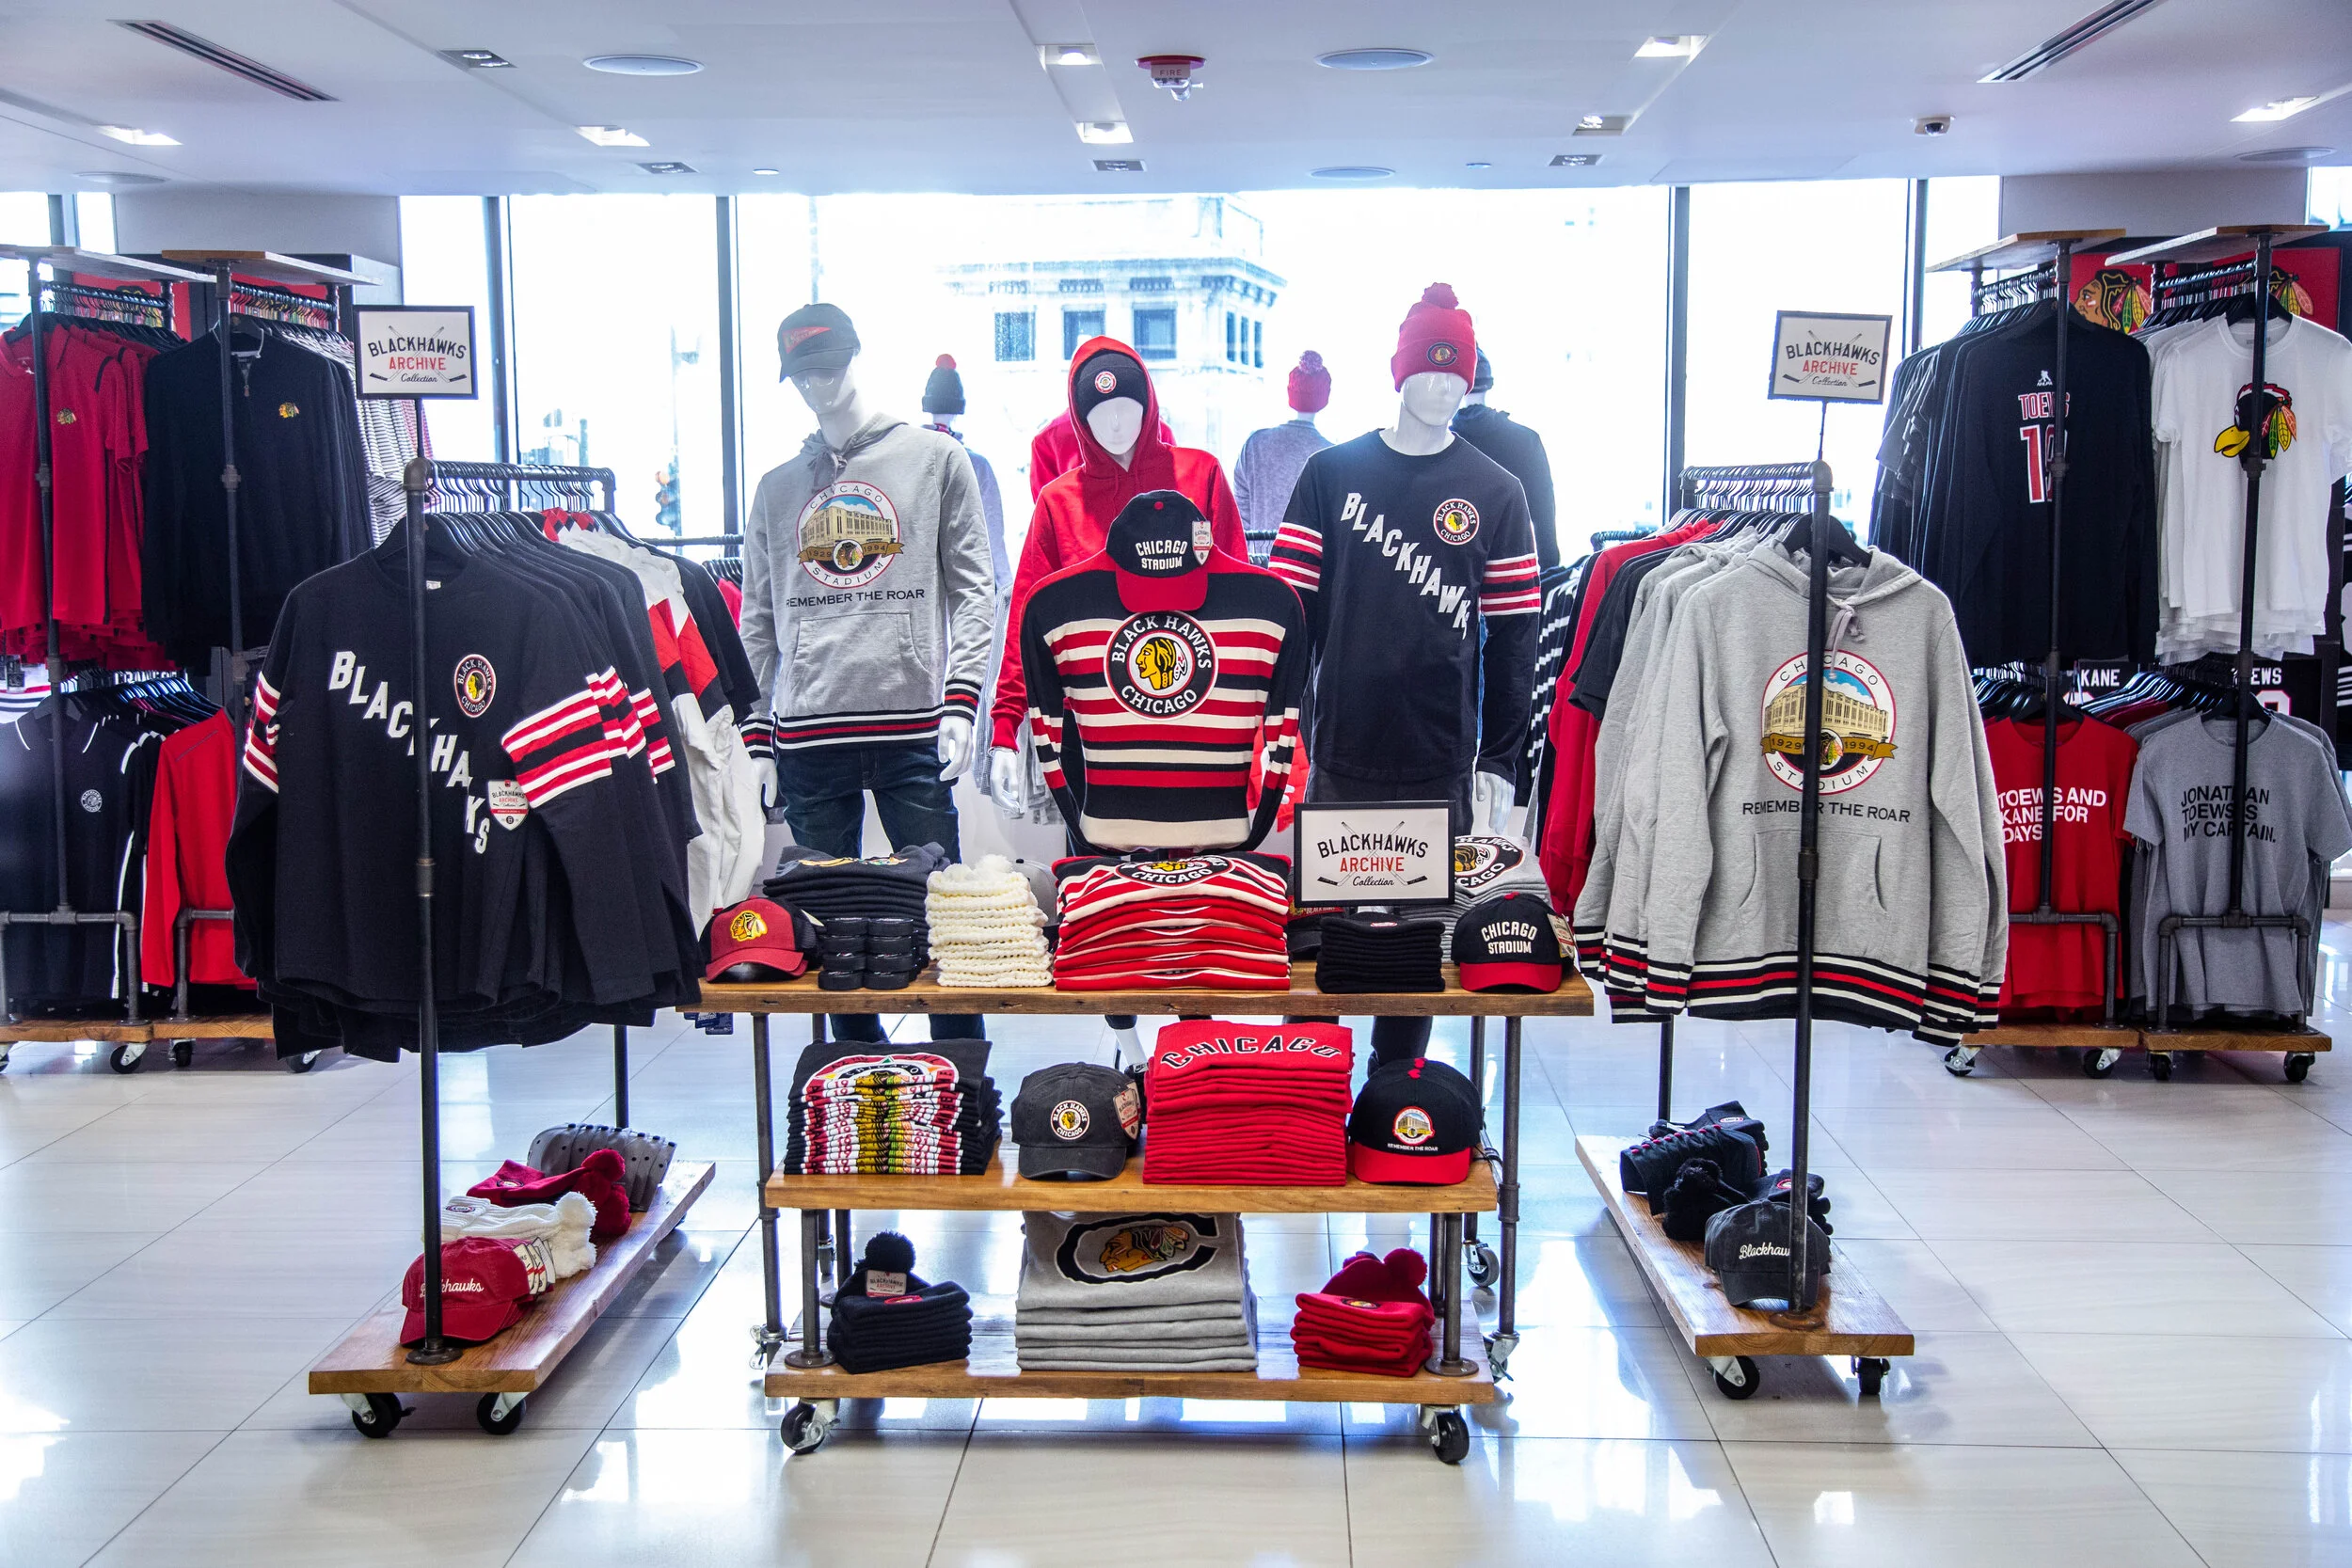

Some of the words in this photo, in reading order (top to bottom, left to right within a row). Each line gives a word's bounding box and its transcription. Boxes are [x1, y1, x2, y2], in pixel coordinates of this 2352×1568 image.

[368, 337, 467, 358] BLACKHAWKS
[1786, 341, 1880, 365] BLACKHAWKS
[389, 356, 447, 371] ARCHIVE
[1803, 359, 1858, 375] ARCHIVE
[401, 373, 438, 382] Collection
[1437, 502, 1456, 522] BLACK
[1457, 502, 1476, 524] HAWKS
[1440, 529, 1470, 542] CHICAGO
[863, 545, 886, 553] 1994
[1136, 540, 1187, 556] CHICAGO
[1141, 556, 1183, 570] STADIUM
[1341, 492, 1471, 640] BLACKHAWK
[812, 562, 884, 585] STADIUM
[787, 593, 852, 608] REMEMBER
[856, 591, 882, 601] THE
[886, 589, 925, 600] ROAR
[1112, 615, 1159, 663] BLACK
[1164, 615, 1212, 669] HAWKS
[457, 659, 476, 685] BLACK
[478, 660, 492, 690] HAWKS
[1780, 654, 1879, 686] CHCAGO
[2080, 669, 2120, 687] KANE
[461, 695, 485, 712] CHICAGO
[1121, 685, 1197, 714] CHICAGO
[329, 651, 490, 854] BLACHAKS
[1771, 737, 1802, 751] 1929
[1844, 741, 1874, 752] 1994
[2066, 786, 2106, 807] AND
[2181, 785, 2269, 807] JONATAN
[1742, 800, 1824, 815] REMEMBR
[1829, 802, 1864, 817] THE
[1867, 806, 1911, 823] ROAR
[2000, 805, 2042, 826] KANE
[2052, 805, 2089, 823] FOR
[2245, 804, 2258, 820] S
[1317, 833, 1429, 858] BLACKHAWKS
[1340, 857, 1405, 873] ARCHIVE
[1454, 863, 1505, 886] CAGO
[1131, 868, 1213, 884] CHICAGO
[1352, 876, 1394, 886] Collection
[1481, 921, 1538, 942] CHICAGO
[1487, 940, 1532, 955] STADIUM
[1161, 1035, 1343, 1069] CHICAGO
[1052, 1102, 1070, 1121] BLACK
[1070, 1102, 1088, 1122] HAWKS
[1057, 1127, 1083, 1137] CHICAGO
[1740, 1242, 1790, 1259] Blackhaw
